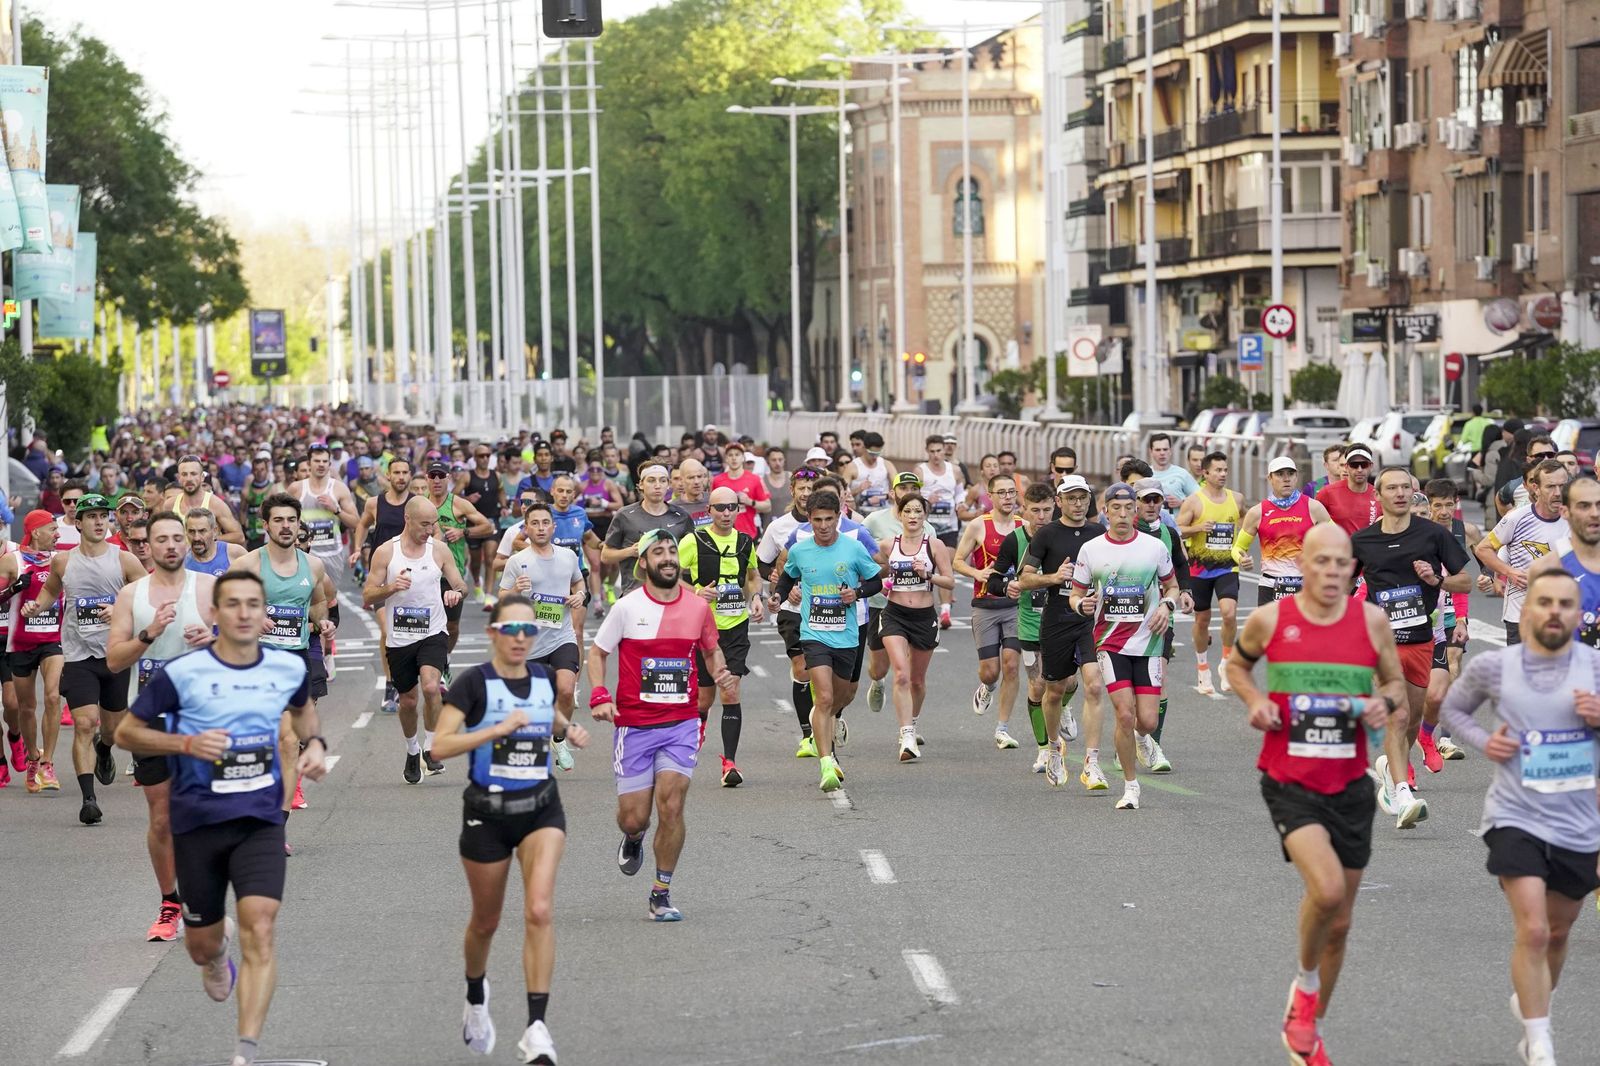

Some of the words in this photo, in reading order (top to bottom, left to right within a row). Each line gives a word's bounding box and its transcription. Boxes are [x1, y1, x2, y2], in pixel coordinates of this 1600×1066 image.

[1396, 316, 1434, 327] TINTE
[1242, 338, 1258, 358] P
[896, 576, 920, 585] CARIOU
[812, 584, 840, 595] BRASI
[1392, 587, 1417, 597] ZURICH
[89, 597, 111, 605] ZURICH
[535, 610, 561, 620] LBERTO
[1109, 605, 1139, 614] CARLOS
[1389, 607, 1418, 620] JULIEN
[28, 617, 57, 625] RICHARD
[78, 617, 92, 625] SEÁN
[809, 615, 846, 623] ALEXANDRE
[271, 626, 298, 636] ORNES
[654, 682, 677, 693] TOMI
[235, 734, 270, 746] ZURICH
[1305, 728, 1343, 743] CLIVE
[1546, 732, 1585, 743] ZURICH
[507, 752, 537, 766] SUSY
[223, 762, 265, 779] SERGIO
[1524, 764, 1593, 778] ALESSANDRO
